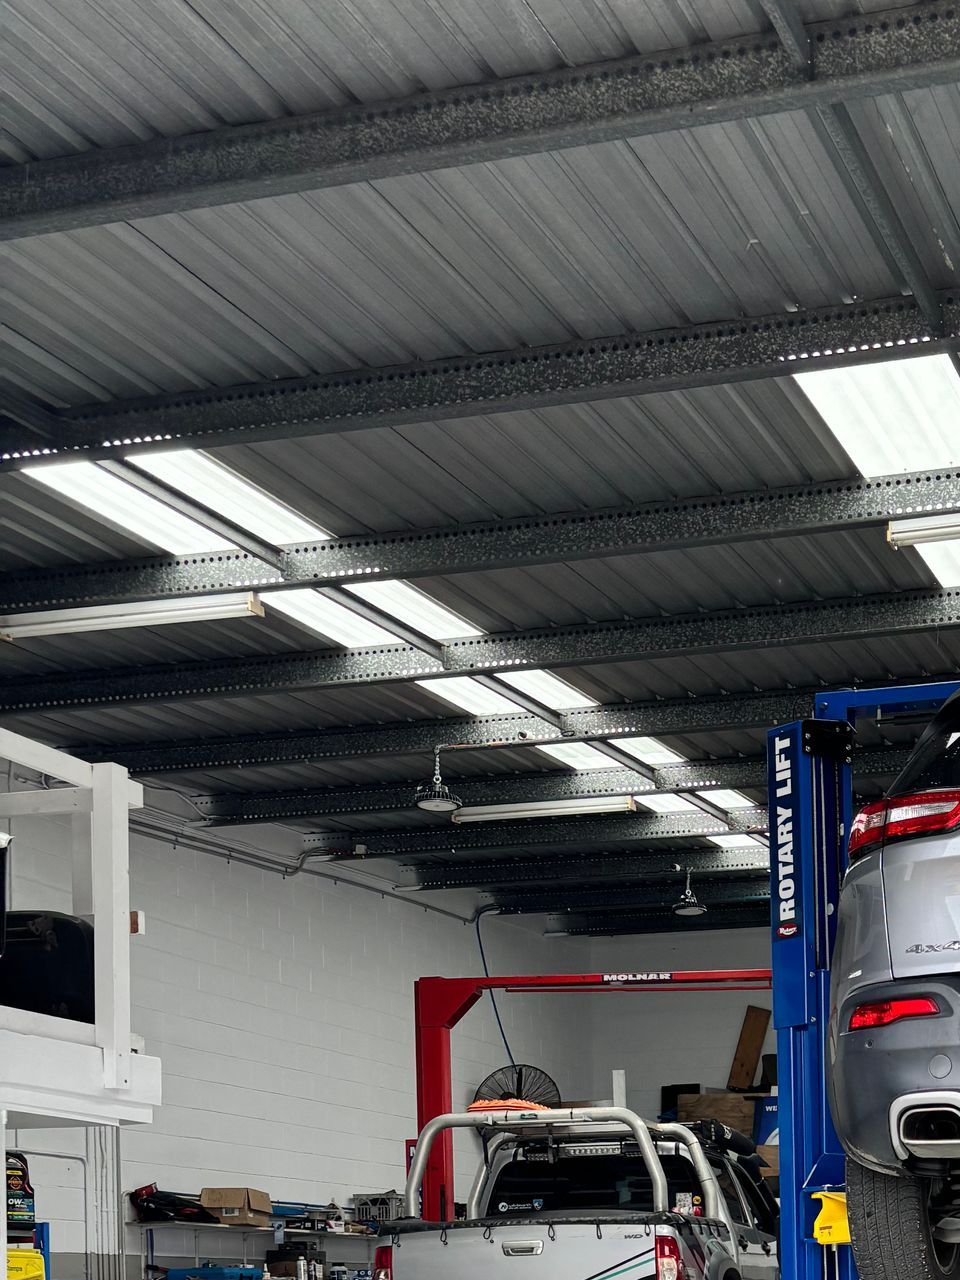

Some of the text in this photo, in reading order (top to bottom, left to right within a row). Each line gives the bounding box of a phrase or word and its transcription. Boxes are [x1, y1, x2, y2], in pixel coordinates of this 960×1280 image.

[775, 736, 796, 921] ROTARY LIFT
[603, 973, 672, 982] MOLNAR
